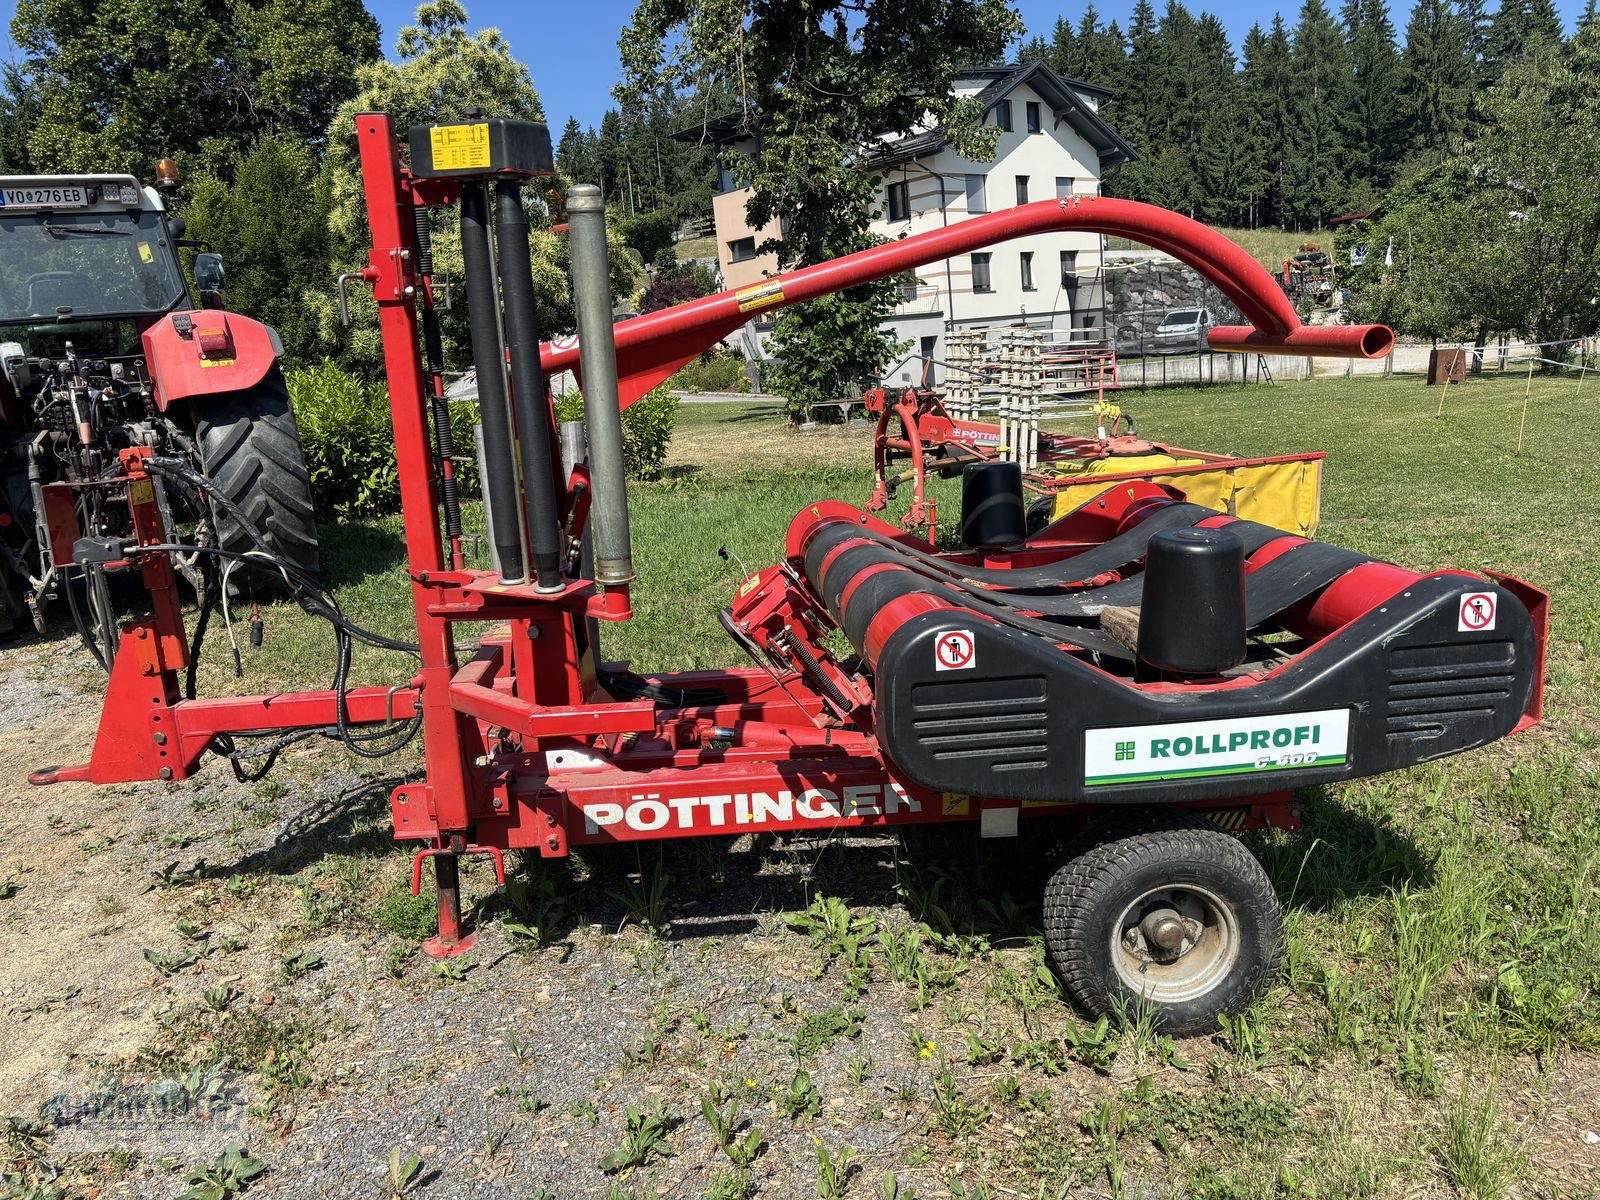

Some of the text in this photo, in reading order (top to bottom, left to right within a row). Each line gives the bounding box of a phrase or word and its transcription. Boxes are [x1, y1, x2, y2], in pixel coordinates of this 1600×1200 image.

[6, 190, 25, 203] VO
[961, 429, 1001, 441] PÖTTIN
[1150, 725, 1321, 759] ROLLPROFI
[1276, 751, 1319, 767] 400
[582, 782, 923, 836] PÖTTINGER
